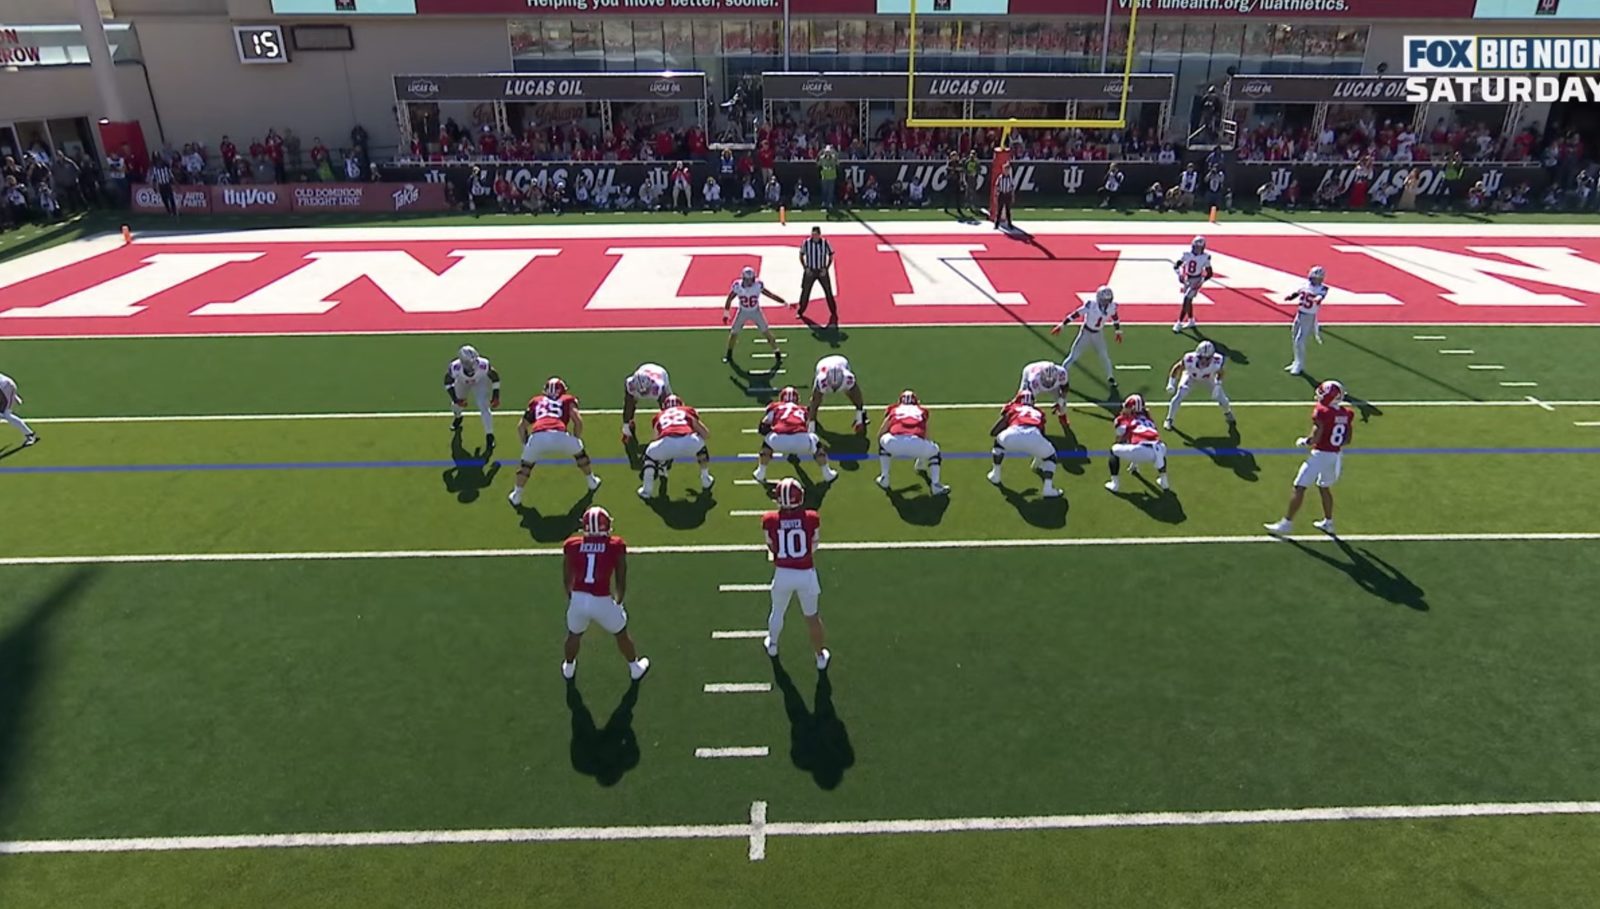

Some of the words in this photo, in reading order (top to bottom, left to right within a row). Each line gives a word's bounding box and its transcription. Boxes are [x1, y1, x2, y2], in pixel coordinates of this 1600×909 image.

[528, 0, 587, 9] Helping
[593, 0, 618, 9] you
[672, 0, 719, 8] better,
[253, 32, 279, 58] 15
[505, 80, 555, 95] LUCAS
[558, 80, 583, 95] OIL
[929, 80, 979, 94] LUCAS
[982, 80, 1005, 94] OIL
[1333, 82, 1381, 97] LUCAS
[295, 188, 313, 197] OLD
[315, 188, 362, 196] DOMINION
[298, 197, 338, 206] FREIGHT
[340, 197, 360, 206] LINE
[1187, 260, 1198, 274] 8
[739, 296, 758, 308] 26
[1095, 316, 1104, 327] 1
[1330, 423, 1346, 447] 8
[777, 529, 808, 558] 10
[584, 553, 596, 583] 1
